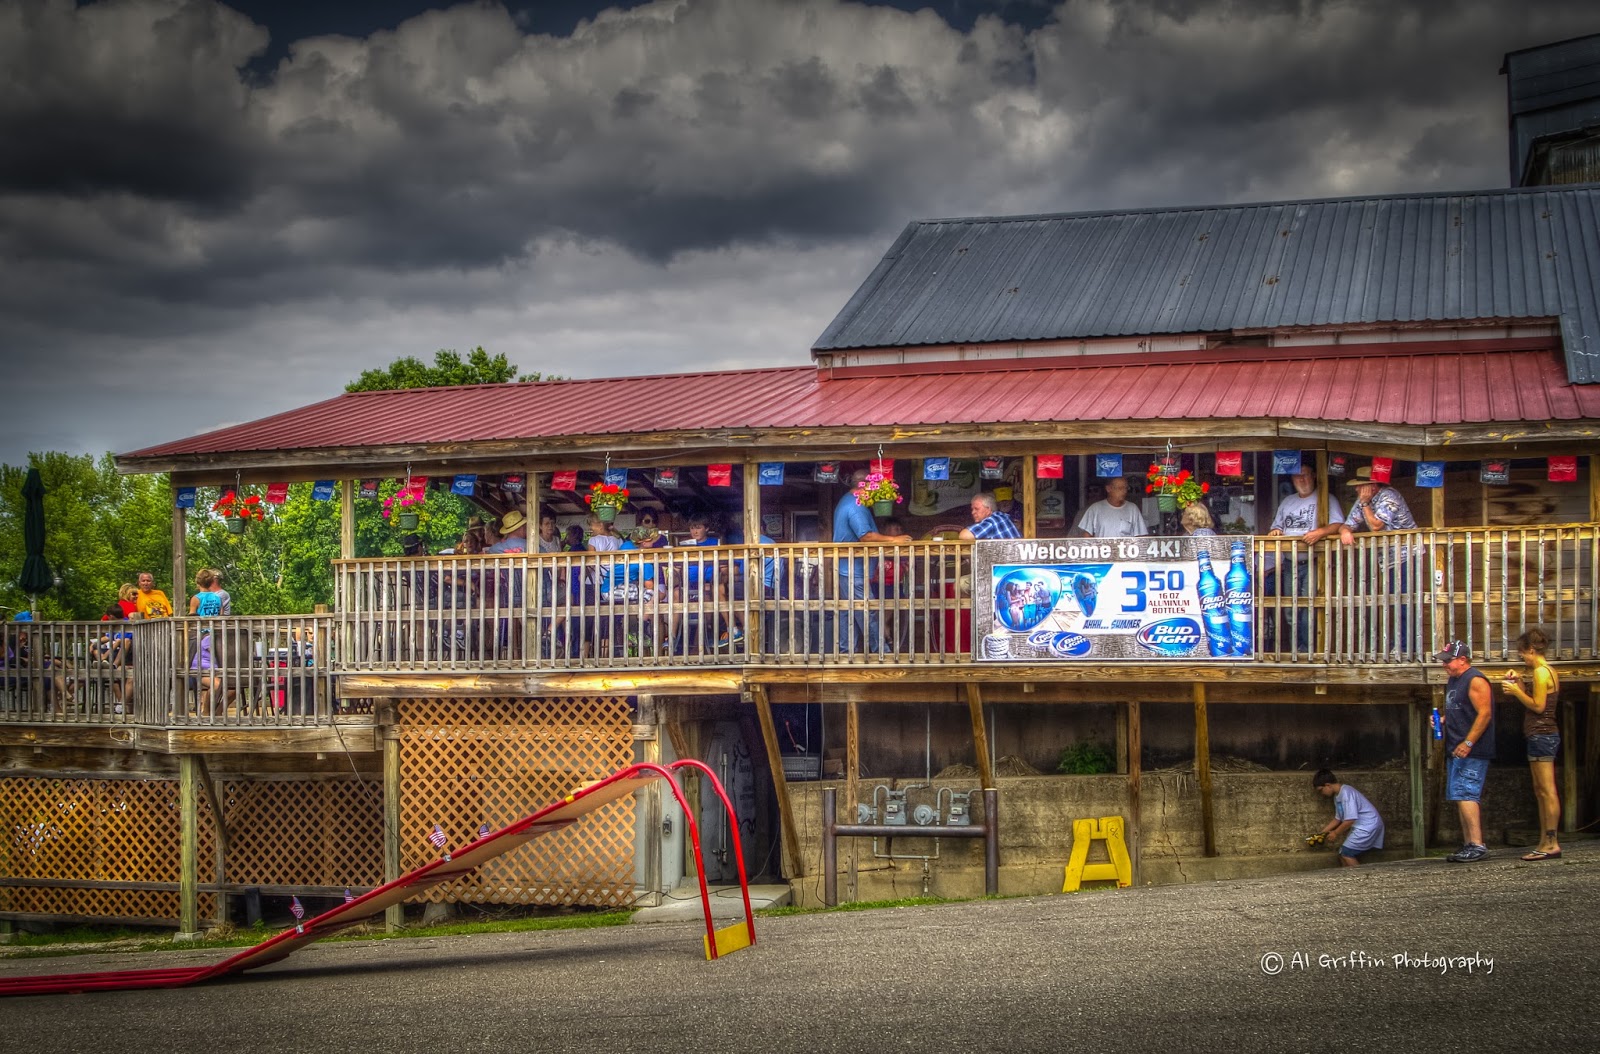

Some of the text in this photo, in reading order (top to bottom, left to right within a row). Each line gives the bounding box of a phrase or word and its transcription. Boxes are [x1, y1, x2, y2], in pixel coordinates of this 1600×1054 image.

[1018, 540, 1181, 560] Welcome to 4K!
[1121, 570, 1185, 613] 3 50
[1203, 595, 1224, 604] BUD
[1154, 625, 1194, 634] BUD
[1148, 635, 1200, 644] LIGHT
